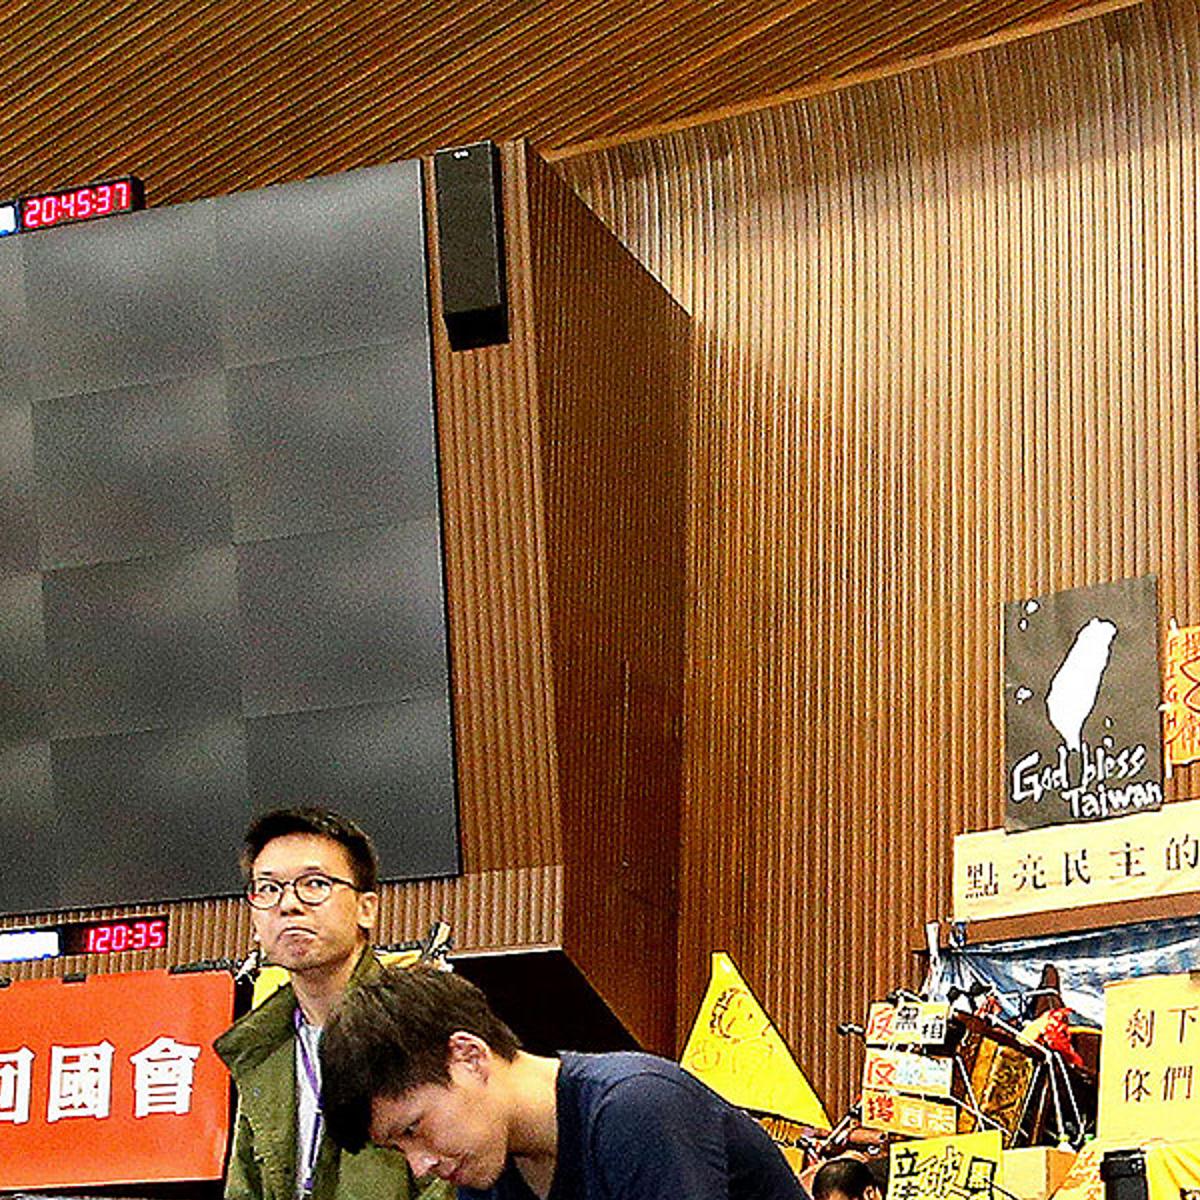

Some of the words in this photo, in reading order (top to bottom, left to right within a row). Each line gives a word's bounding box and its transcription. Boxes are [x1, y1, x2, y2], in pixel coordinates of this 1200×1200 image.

[25, 183, 128, 226] 20:45:37
[1011, 745, 1068, 803] God
[1081, 744, 1147, 789] bless
[1061, 781, 1163, 819] Taiwan
